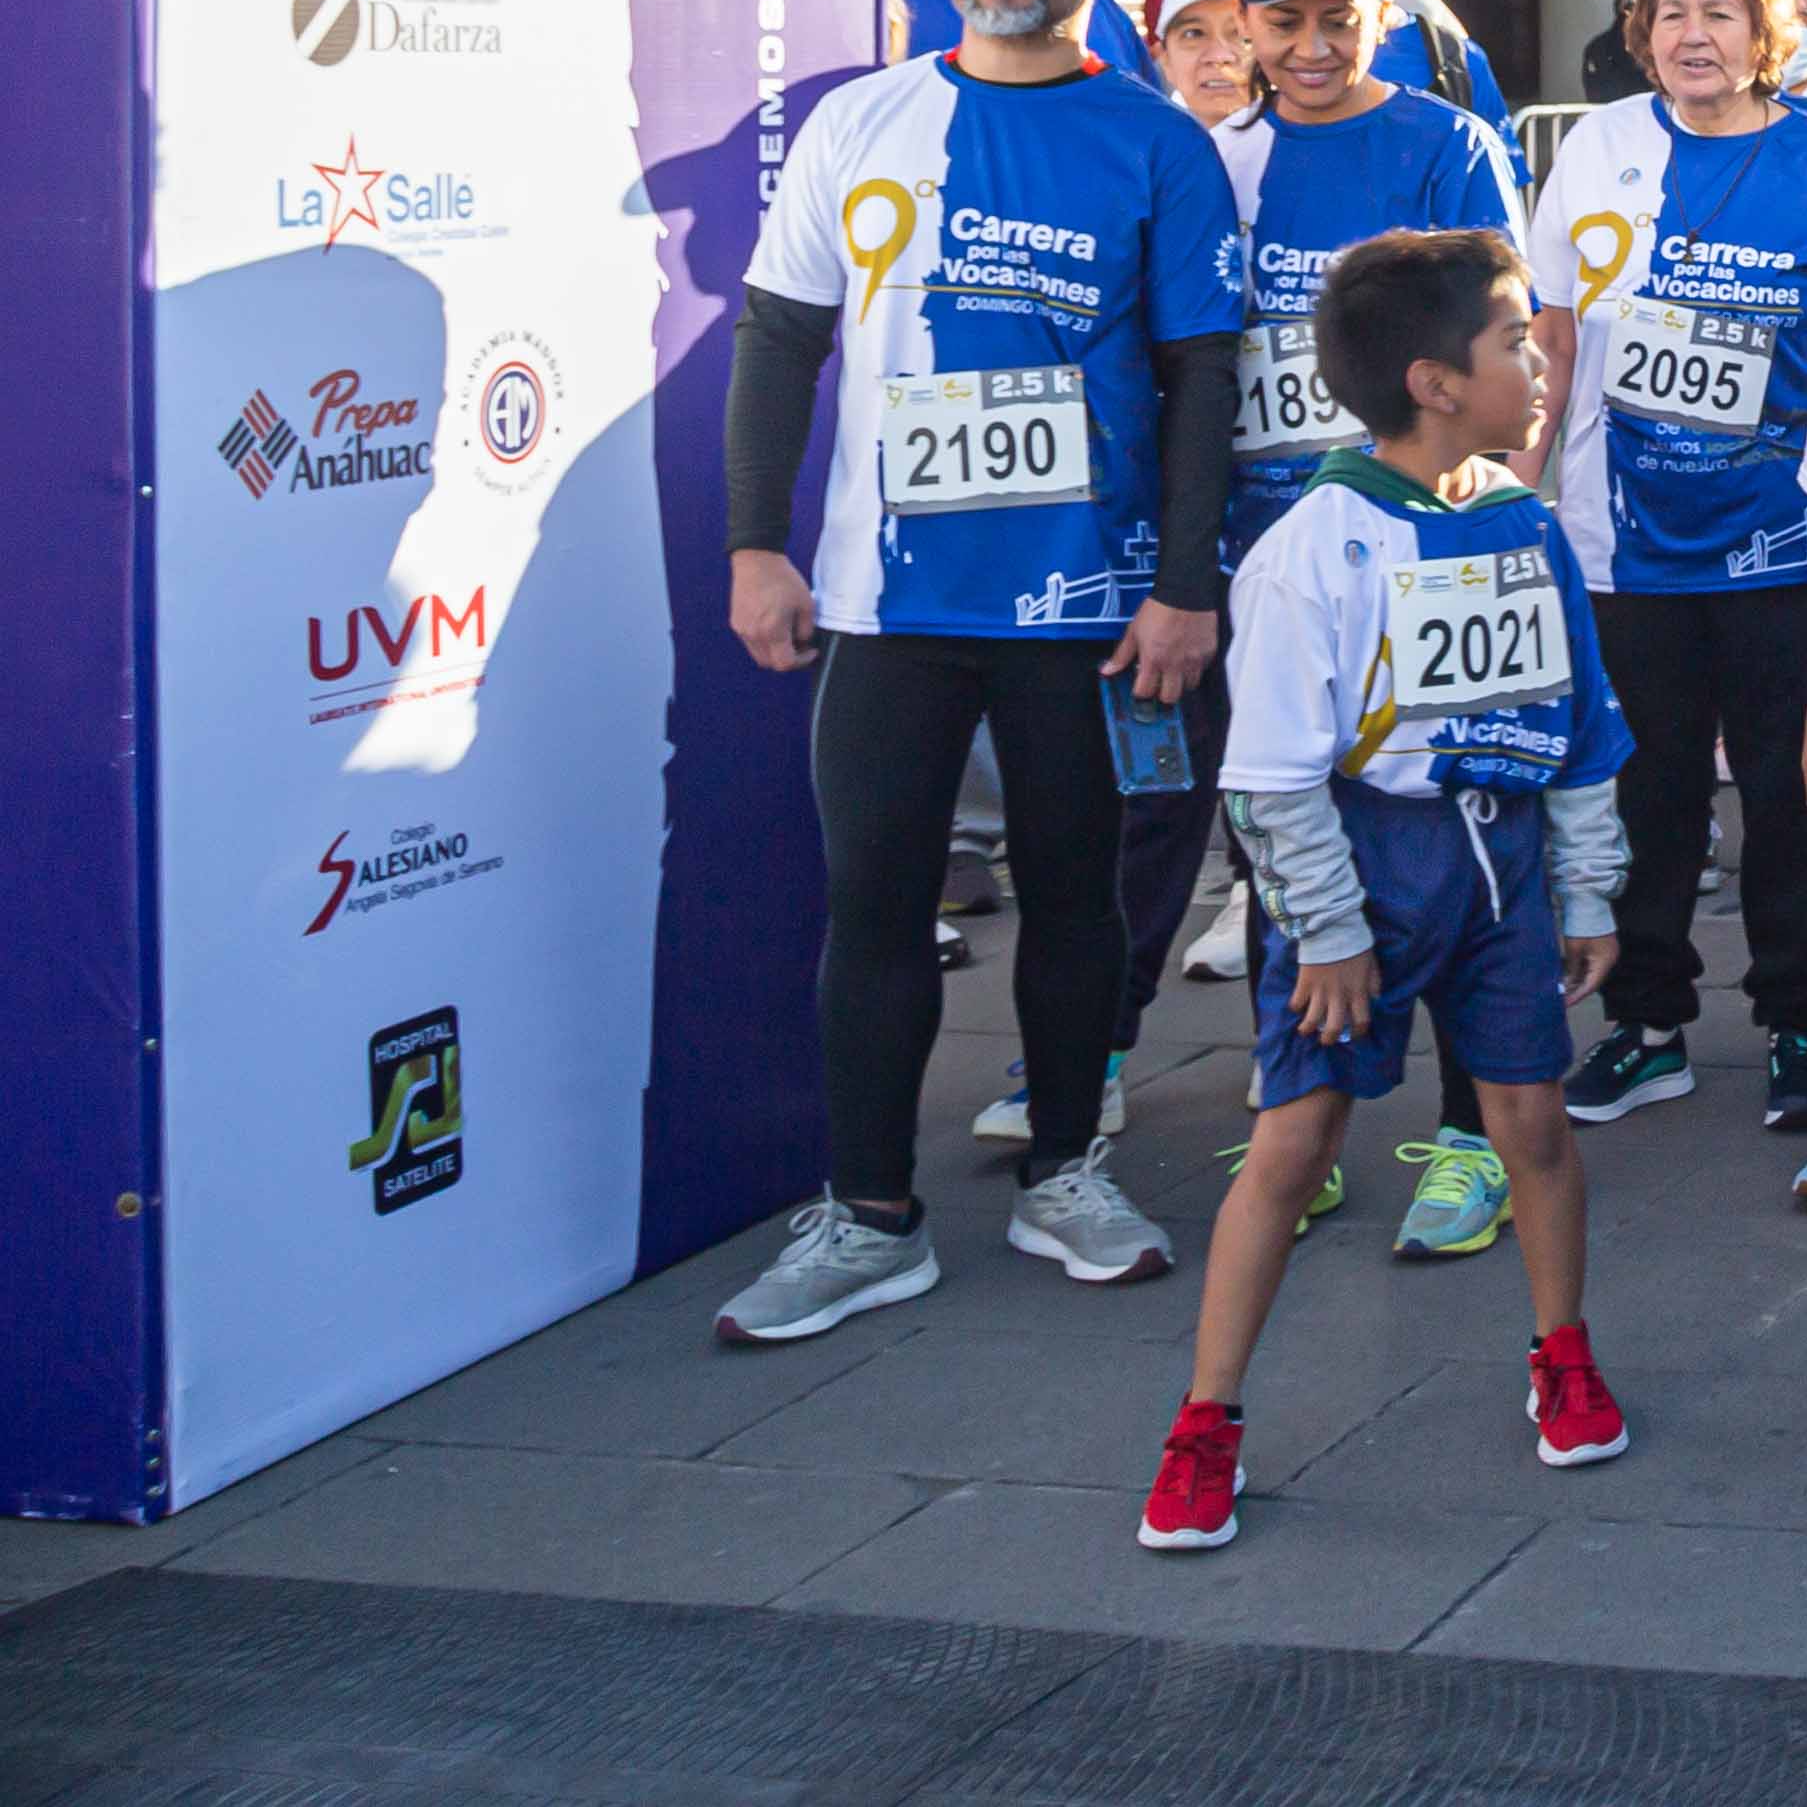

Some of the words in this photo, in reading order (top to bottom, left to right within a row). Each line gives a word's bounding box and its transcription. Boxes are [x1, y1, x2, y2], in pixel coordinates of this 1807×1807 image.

[367, 1, 503, 54] Dafarza
[277, 178, 323, 227] La
[386, 173, 475, 222] Salle
[950, 207, 1097, 262] Carrera
[1660, 234, 1796, 270] Carrera
[1650, 275, 1800, 306] Vocaciones
[1673, 263, 1705, 279] por
[1708, 263, 1735, 281] las
[956, 296, 1034, 315] DOMINGO
[1700, 317, 1744, 343] 2.5
[1751, 329, 1768, 349] k
[991, 371, 1046, 399] 2.5
[1617, 340, 1745, 411] 2095
[309, 369, 418, 439] Prepa
[1233, 372, 1339, 438] 189
[289, 434, 432, 494] Anáhuac
[906, 417, 1056, 488] 2190
[308, 584, 485, 681] UVM
[1418, 603, 1545, 690] 2021
[375, 1022, 454, 1064] HOSPITAL
[383, 1153, 455, 1198] SATELITE
